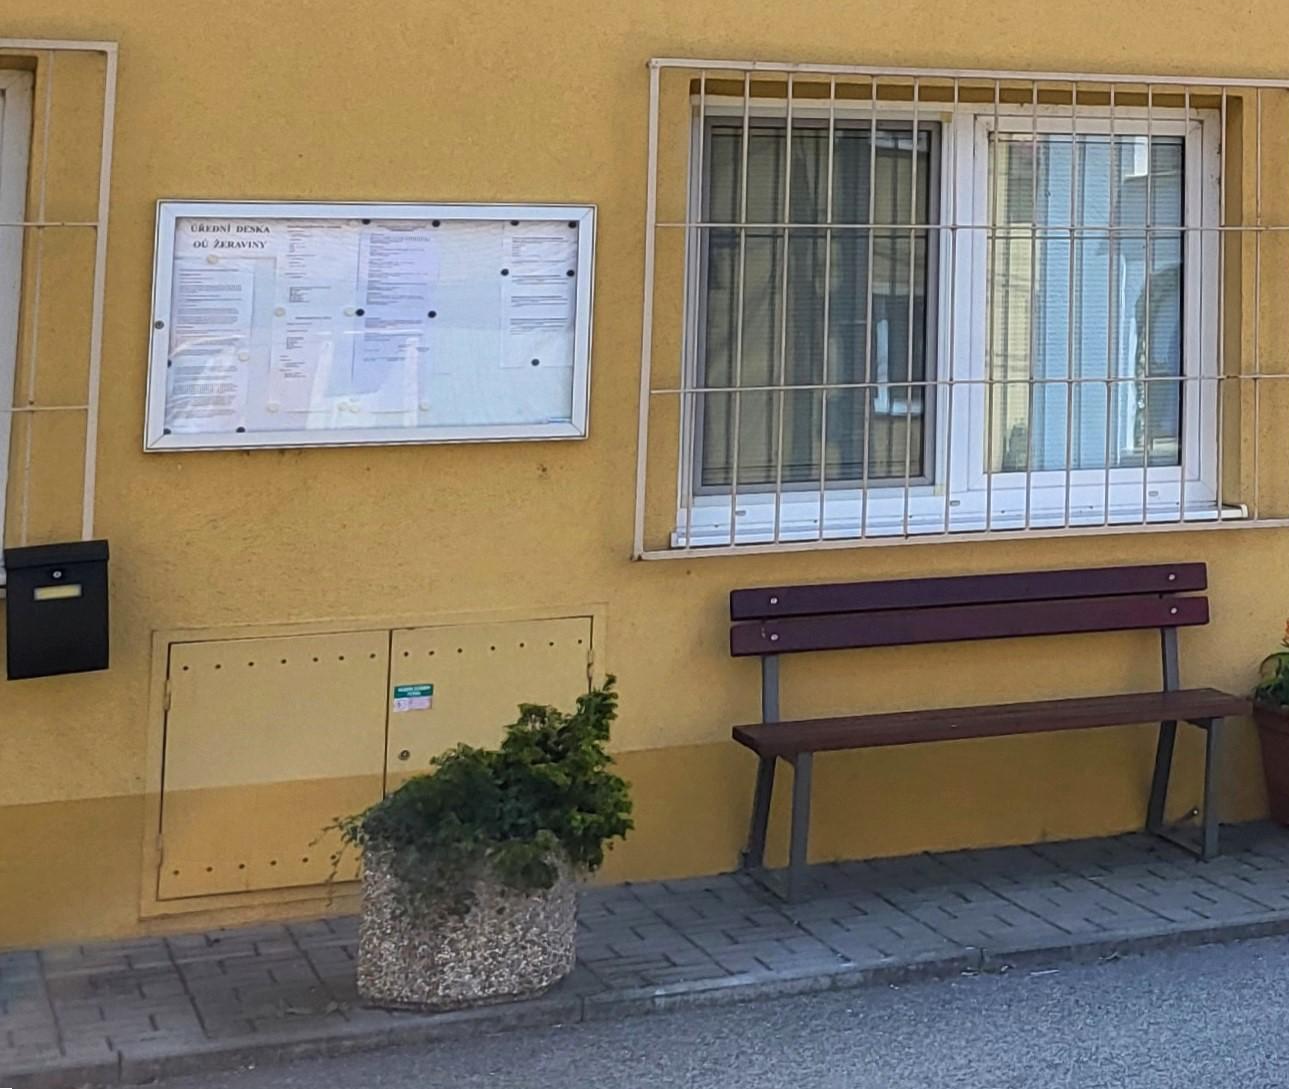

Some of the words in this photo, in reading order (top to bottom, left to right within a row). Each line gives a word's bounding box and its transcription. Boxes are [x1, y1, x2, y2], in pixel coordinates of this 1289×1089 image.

[190, 223, 231, 233] ÚŘEDNÍ
[236, 224, 271, 233] DESKA
[192, 237, 209, 249] OÚ
[213, 239, 267, 249] ŽERAVINY
